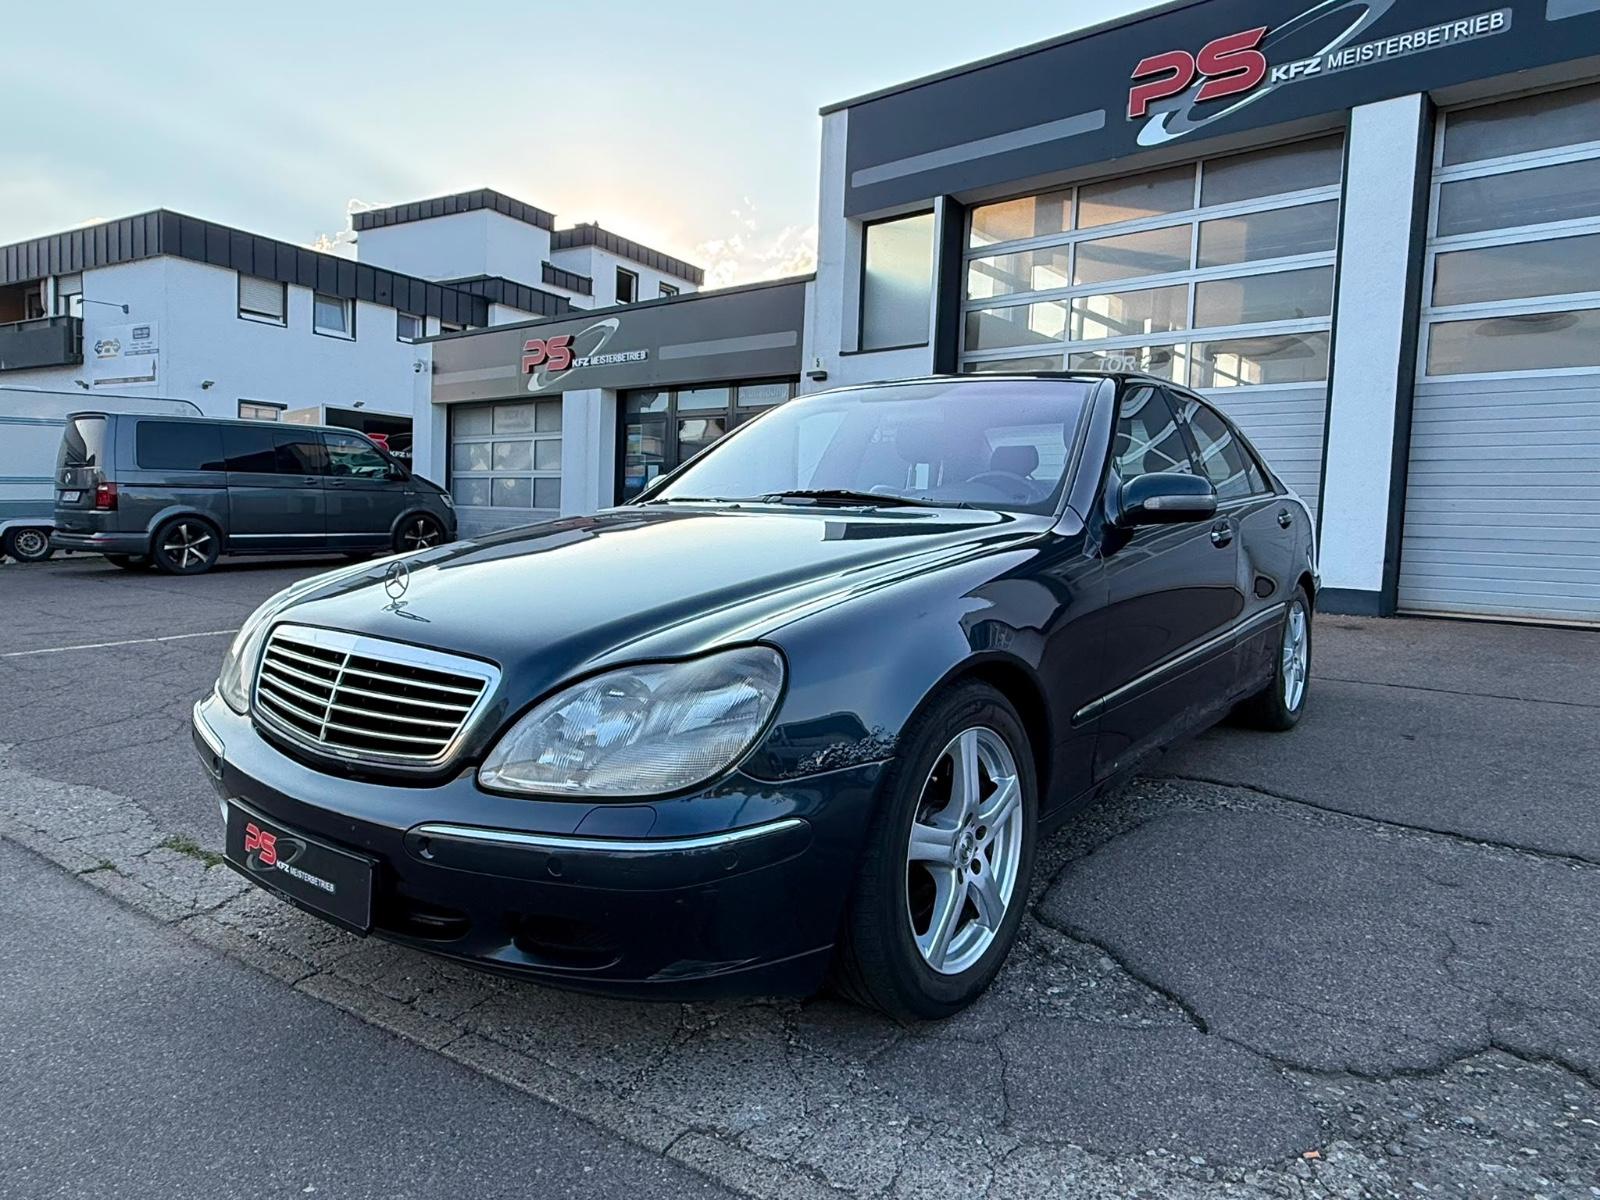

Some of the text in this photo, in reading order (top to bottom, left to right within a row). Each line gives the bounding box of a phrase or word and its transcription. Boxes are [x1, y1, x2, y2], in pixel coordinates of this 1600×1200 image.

[1271, 12, 1504, 83] KFZ MEISTERBETRIEB
[1128, 25, 1268, 118] PS
[522, 335, 573, 373] PS
[572, 350, 646, 367] KFZ MEISTERBETRIEB
[1098, 355, 1136, 371] TOR
[389, 450, 405, 458] KFZ
[244, 822, 277, 865] PS
[276, 859, 335, 893] KFZ MEISTERBETRIEB
